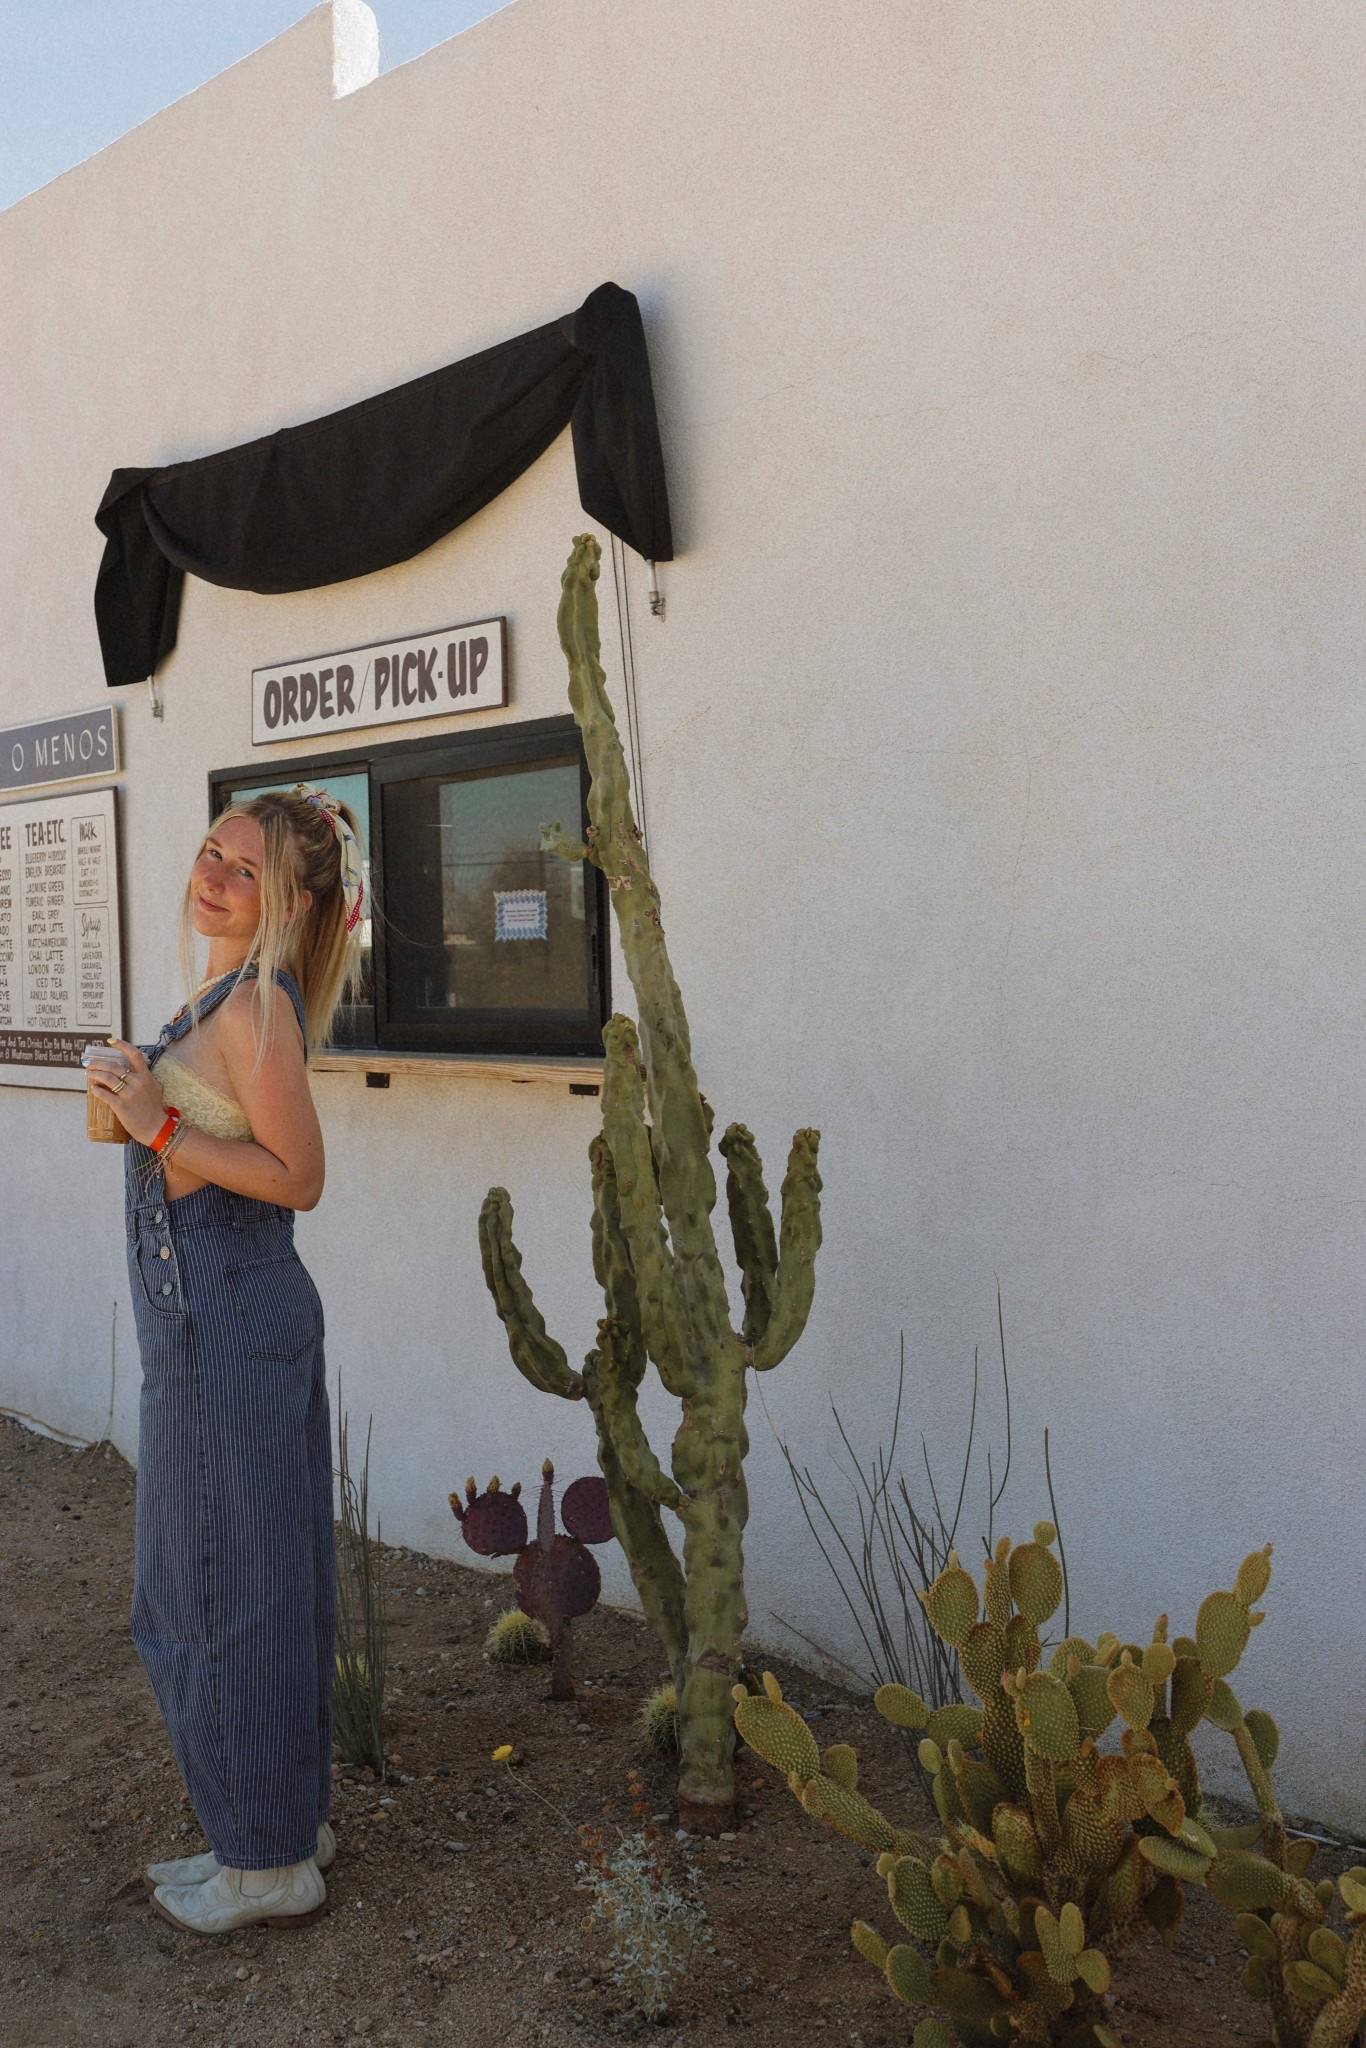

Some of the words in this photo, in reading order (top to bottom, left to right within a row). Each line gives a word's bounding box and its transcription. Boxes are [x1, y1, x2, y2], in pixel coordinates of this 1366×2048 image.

[11, 743, 25, 772] O
[35, 725, 108, 768] MENOS
[48, 880, 65, 892] GREEN
[32, 910, 46, 921] EARL
[48, 909, 60, 920] GREY
[28, 923, 46, 935] MATCHA
[49, 922, 64, 934] LATTE
[29, 950, 43, 962] CHAI
[46, 949, 64, 962] LATTE
[81, 951, 103, 960] LAVENDER
[28, 963, 49, 975] LONDON
[54, 963, 65, 975] FOG
[36, 977, 49, 989] ICED
[51, 977, 63, 988] TEA
[30, 990, 48, 1001] ARNOLD
[50, 990, 69, 1001] PALMER
[35, 1003, 62, 1015] LEMONADE
[27, 1016, 37, 1027] HOT
[39, 1016, 67, 1029] CHOCOLATE
[73, 1038, 87, 1052] HOT
